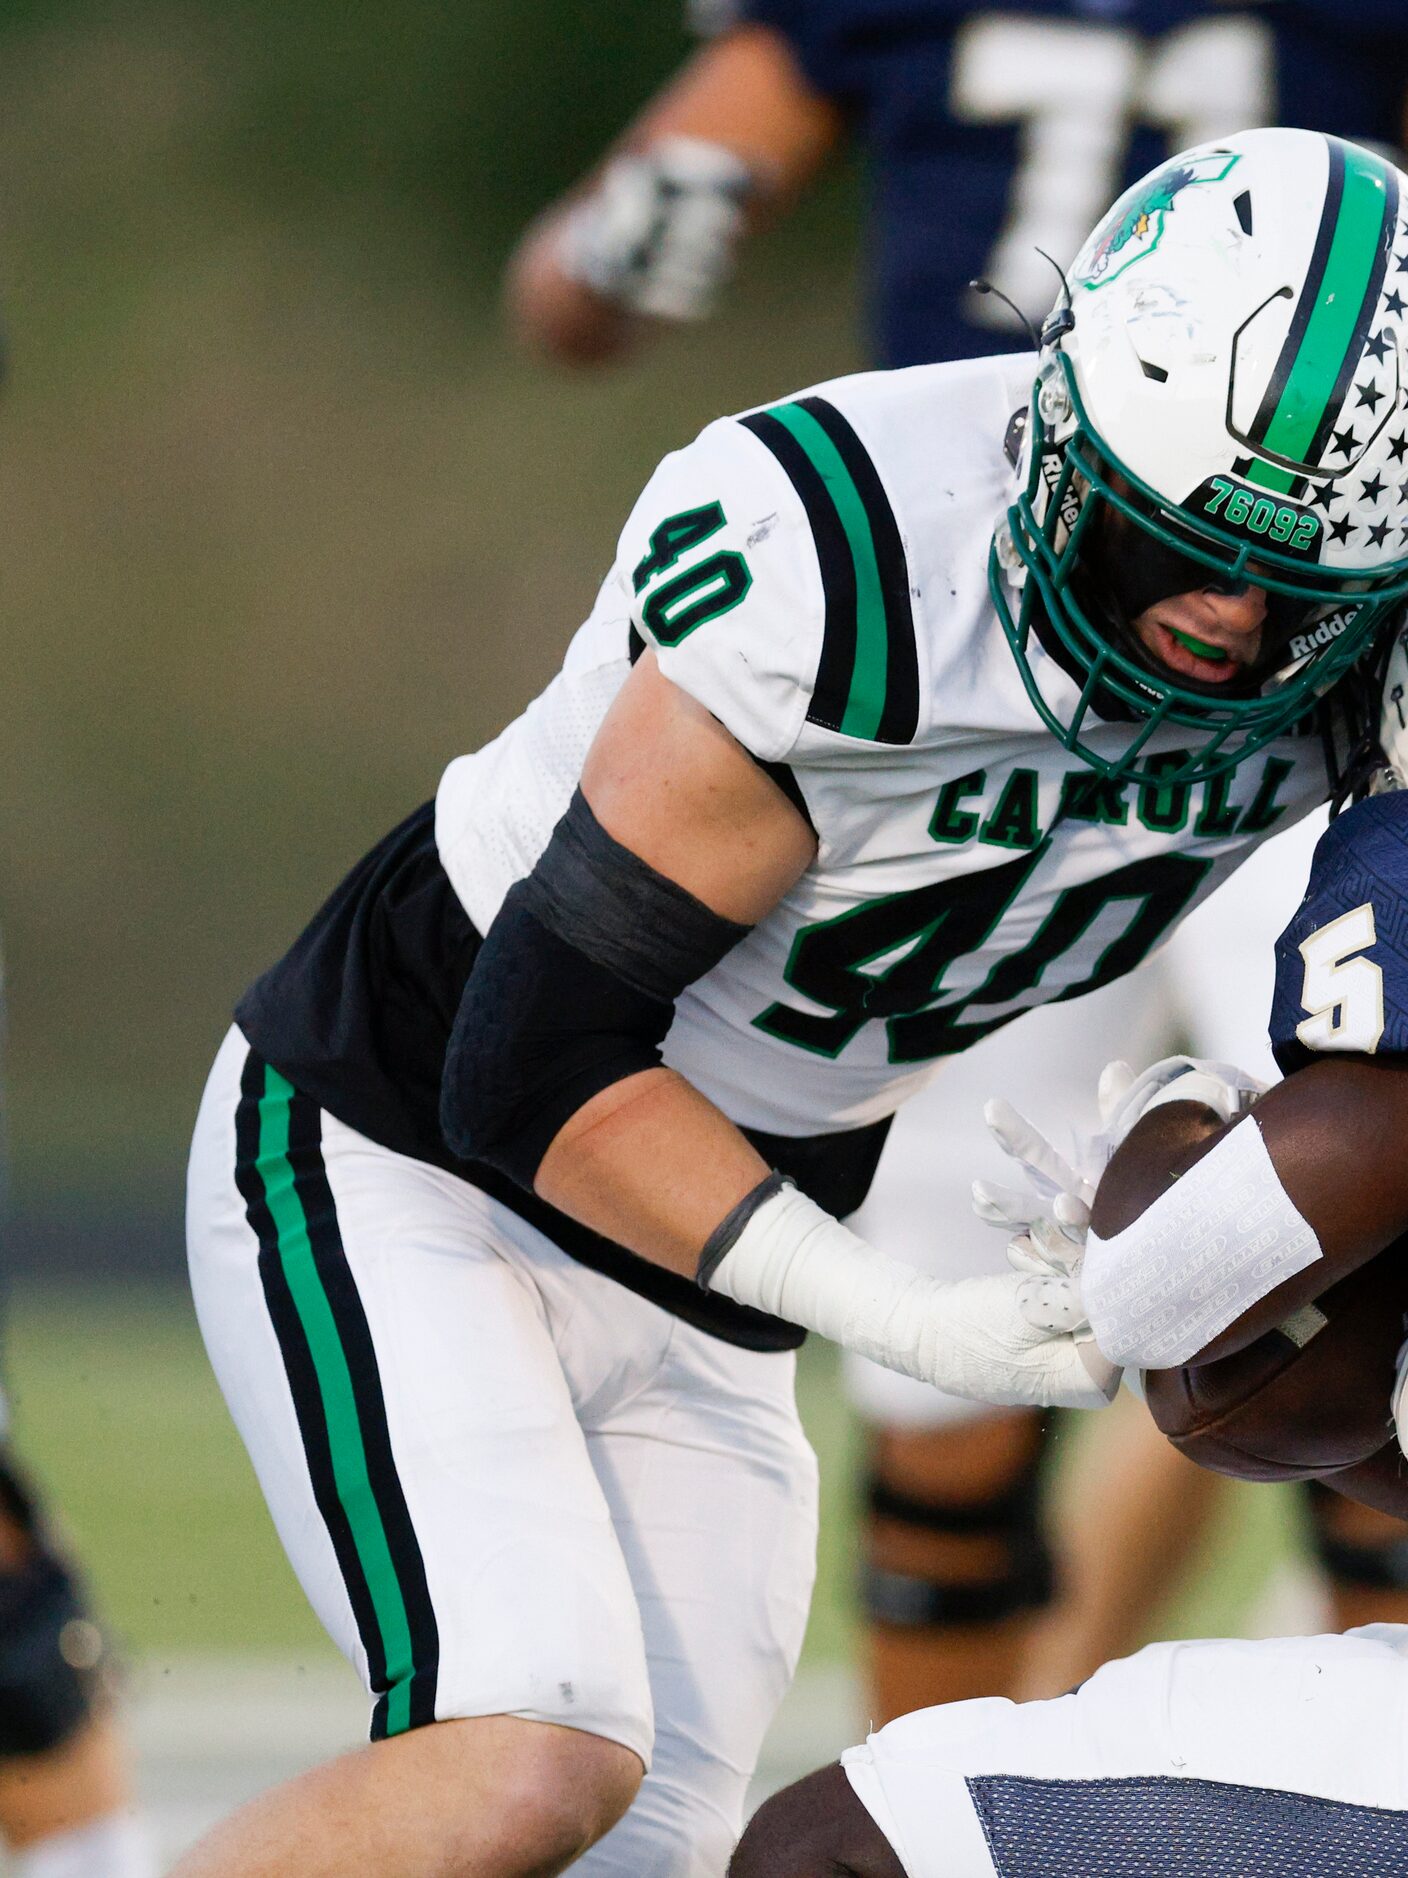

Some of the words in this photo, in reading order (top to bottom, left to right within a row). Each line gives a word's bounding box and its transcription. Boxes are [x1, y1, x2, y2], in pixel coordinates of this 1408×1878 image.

[633, 499, 753, 648] 40
[1204, 477, 1320, 550] 76092
[750, 838, 1214, 1064] 40
[1296, 902, 1385, 1055] 5
